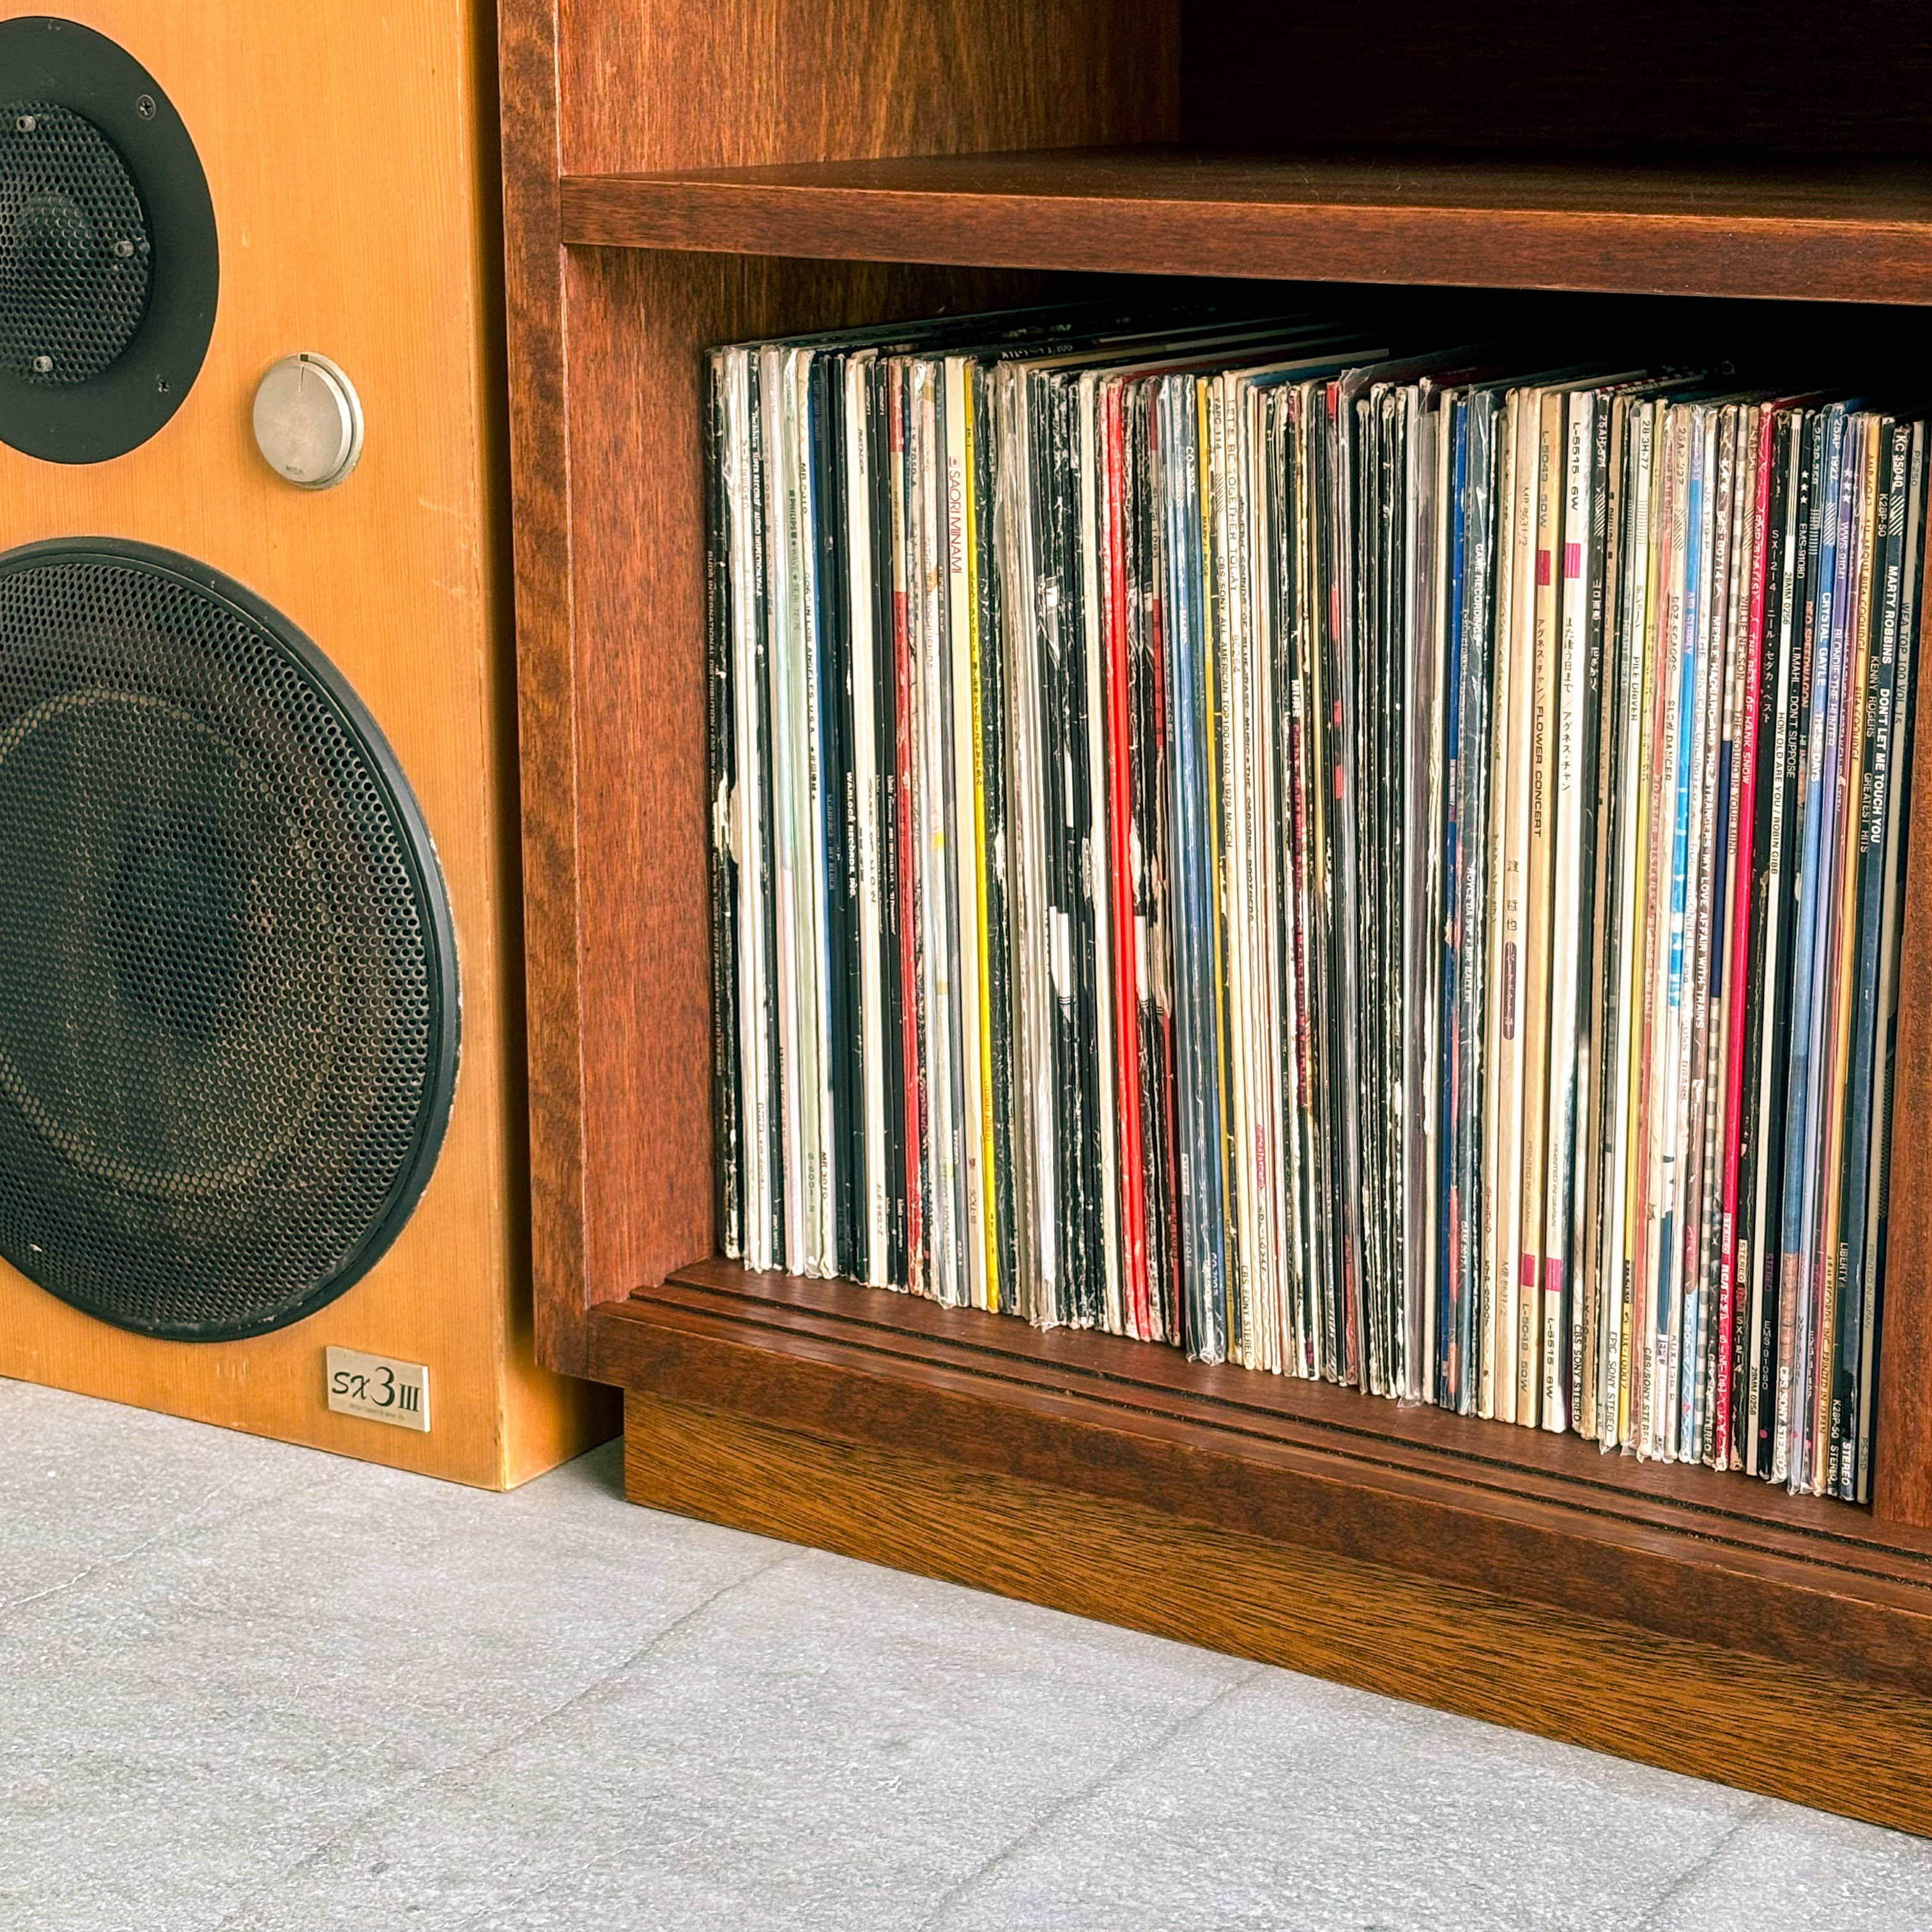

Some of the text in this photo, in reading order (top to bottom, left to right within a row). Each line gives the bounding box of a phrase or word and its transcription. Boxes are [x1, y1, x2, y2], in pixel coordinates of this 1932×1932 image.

[1892, 434, 1906, 488] KC 35040
[948, 470, 961, 513] SAORI
[1228, 470, 1237, 539] TOGETHER
[753, 511, 762, 535] AUDIO
[1877, 493, 1887, 537] K28P-50
[1229, 549, 1238, 591] TODAY
[1797, 523, 1806, 578] EMS-91080
[1473, 543, 1483, 643] GAME RECORDINGS
[1783, 571, 1791, 599] 28MM
[1684, 615, 1694, 654] SUPPLY
[1880, 565, 1897, 664] MARTY ROBBINS
[1900, 601, 1910, 627] WEA
[1710, 615, 1719, 659] MERLE
[1816, 592, 1830, 686] CRYSTAL GAYLE
[1898, 630, 1908, 654] TOP
[1707, 662, 1717, 716] HAGGARD
[1897, 659, 1907, 680] 100
[1630, 682, 1639, 721] DRIVER
[1741, 632, 1756, 784] THE BEST OF HANK SNOW
[1786, 647, 1801, 778] LIMAHL DON'T SUPPOSE
[1865, 656, 1879, 738] KENNY ROGERS
[1706, 723, 1715, 746] AND
[1727, 594, 1748, 855] WILLIE NELSON THE SOUND IN YOUR MIND
[1775, 712, 1784, 735] HOW
[1775, 738, 1784, 758] OLD
[1811, 712, 1823, 783] THESE DAYS
[1869, 687, 1889, 843] DON'T LET ME TOUCH YOU
[1533, 705, 1544, 837] FLOWER CONCERT
[1774, 762, 1782, 783] ARE
[847, 770, 855, 822] WARLOCK
[1773, 785, 1782, 807] YOU
[1860, 772, 1873, 853] GREATEST HITS
[1771, 816, 1781, 848] ROBIN
[1701, 854, 1710, 871] MY
[1770, 851, 1779, 875] GIBB
[848, 877, 856, 899] INC.
[1466, 867, 1474, 902] ROYCE
[1699, 876, 1710, 907] LOVE
[1698, 911, 1708, 952] AFFAIR
[1697, 955, 1706, 986] WITH
[1695, 989, 1705, 1029] TRAINS
[1838, 1241, 1848, 1282] LIBERTY
[1572, 1381, 1581, 1423] STEREO
[1606, 1392, 1615, 1433] STEREO
[1641, 1404, 1650, 1444] STEREO
[1828, 1399, 1841, 1481] K28P-50 STEREO
[1775, 1425, 1786, 1468] STEREO
[1841, 1441, 1851, 1486] STEREO
